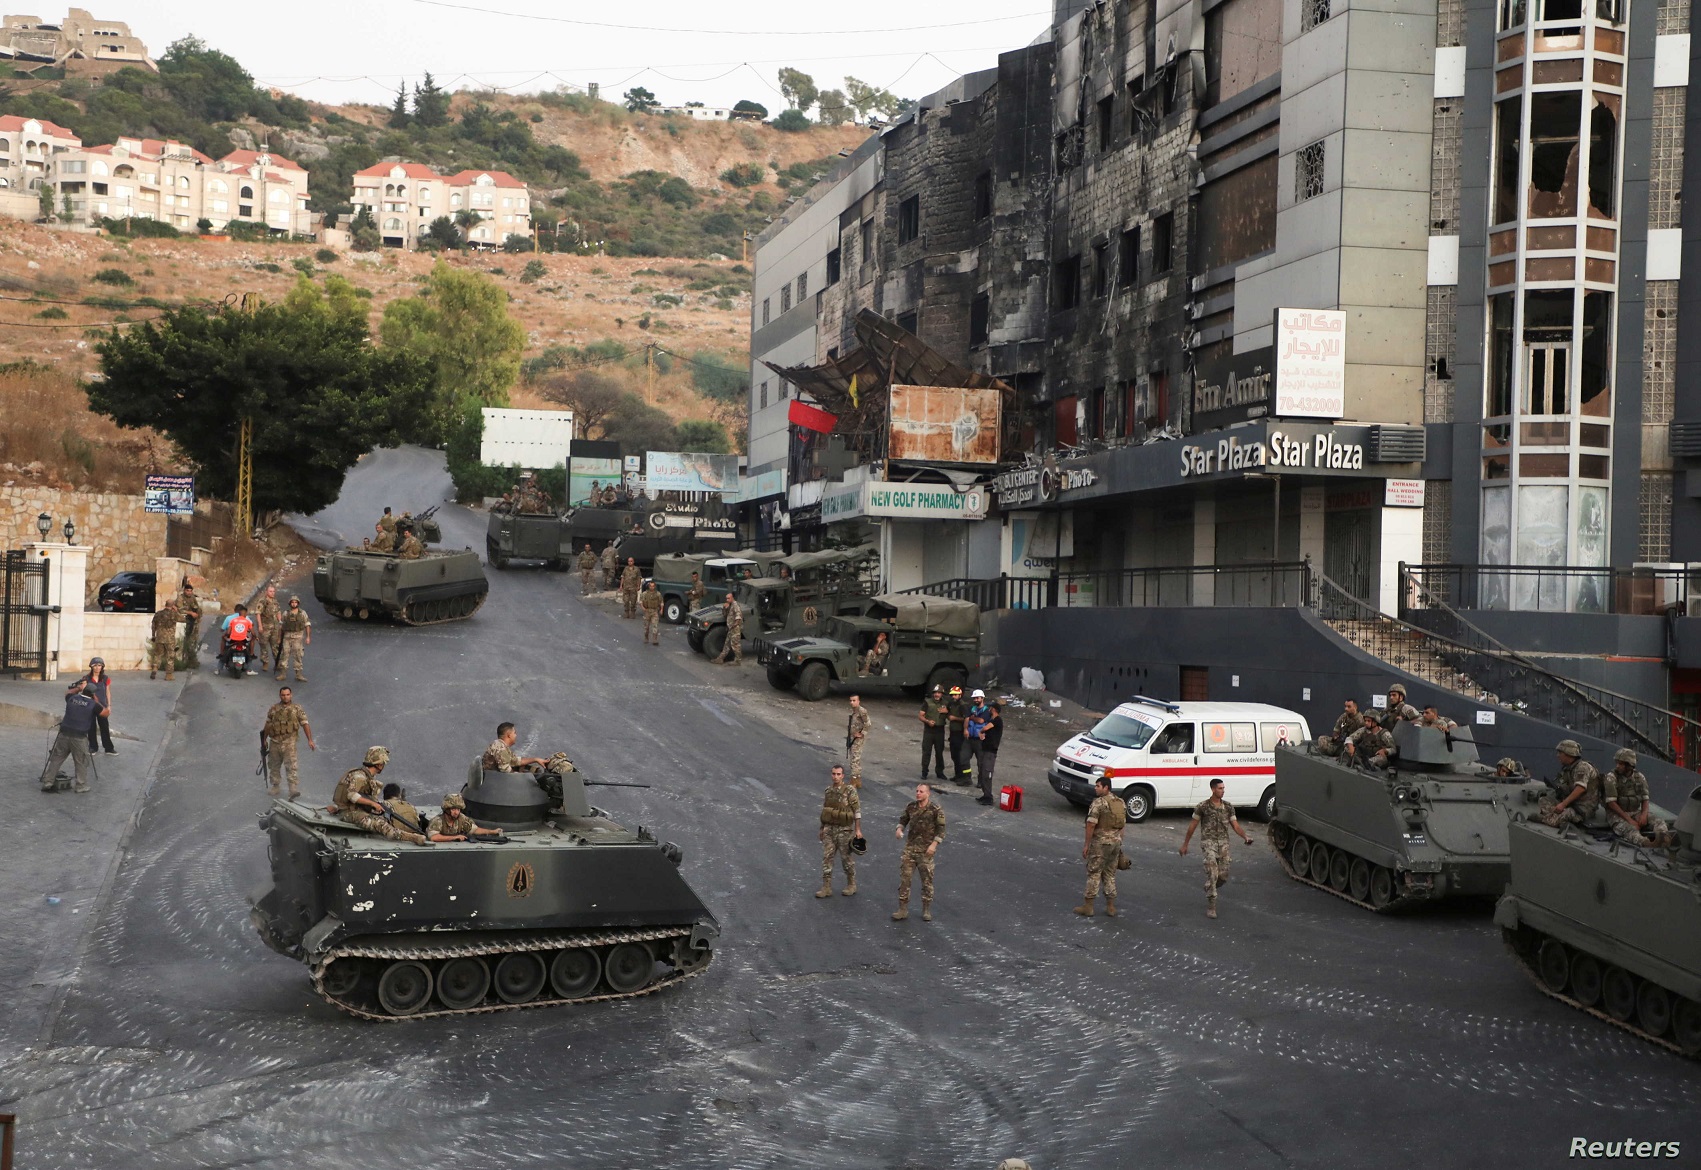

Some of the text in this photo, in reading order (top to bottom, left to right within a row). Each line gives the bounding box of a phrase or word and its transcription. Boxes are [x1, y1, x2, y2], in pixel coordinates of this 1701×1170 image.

[1283, 313, 1341, 334] مكاتب
[1283, 337, 1339, 361] للإيجار
[1280, 397, 1341, 413] 70-432000
[1181, 436, 1265, 477] Star Plaza
[1270, 432, 1363, 469] Star Plaza
[665, 502, 699, 513] Studio
[871, 491, 966, 510] NEW GOLF PHARMACY
[694, 517, 736, 529] PhoTo
